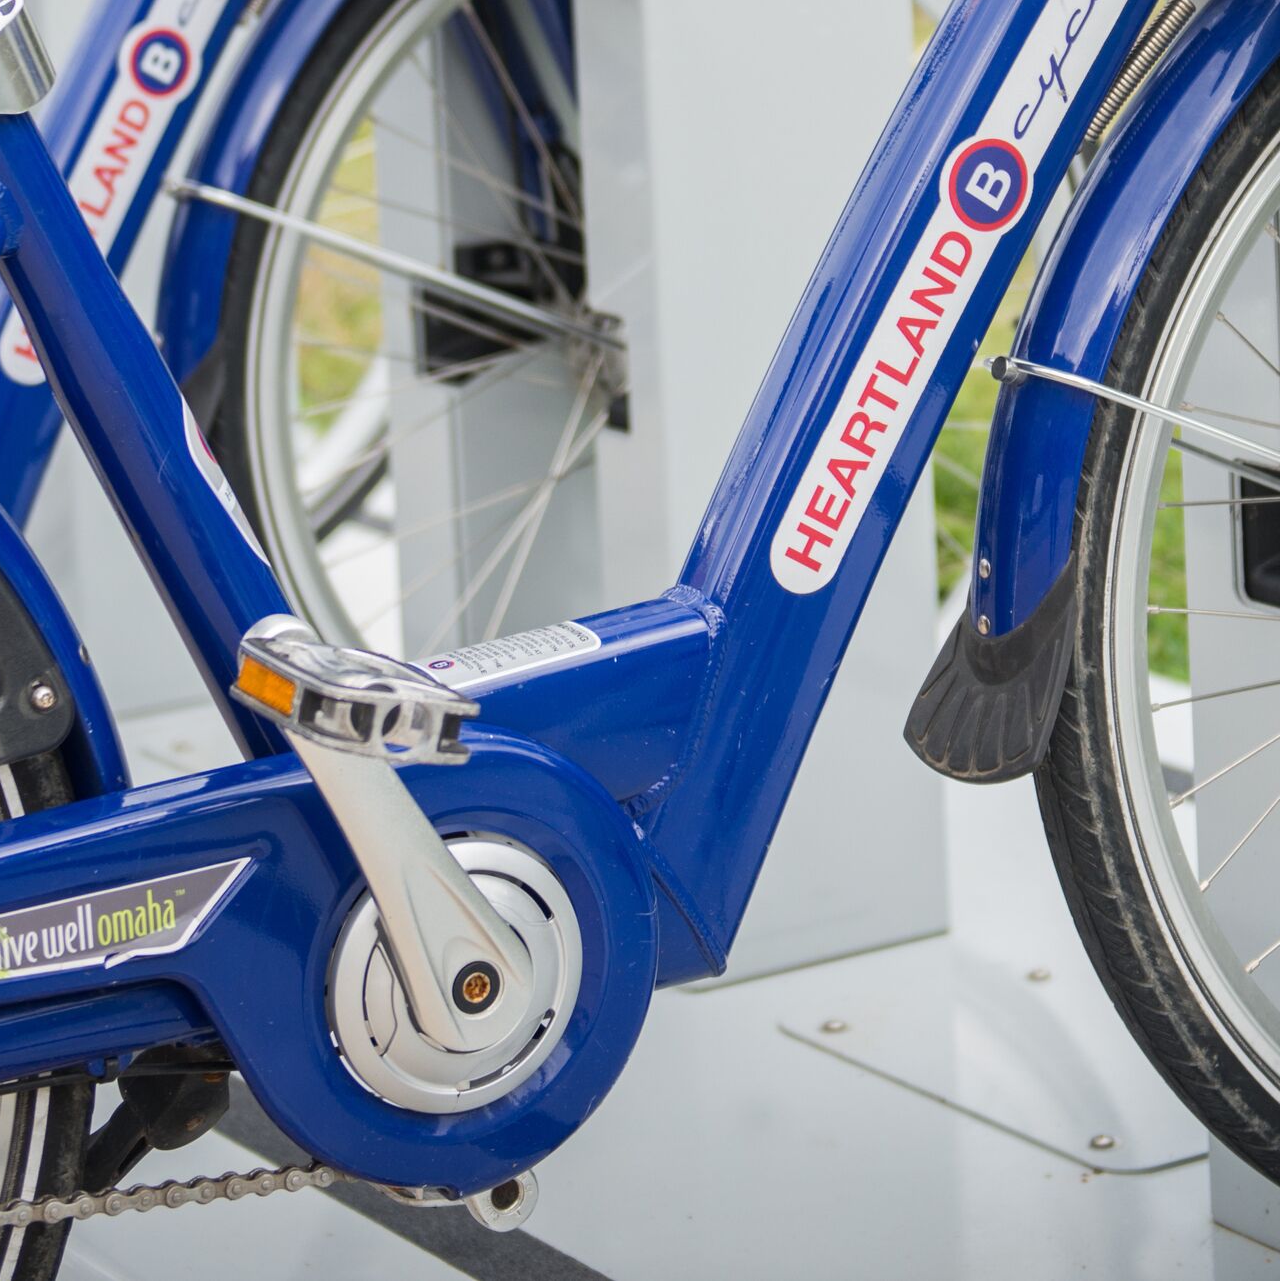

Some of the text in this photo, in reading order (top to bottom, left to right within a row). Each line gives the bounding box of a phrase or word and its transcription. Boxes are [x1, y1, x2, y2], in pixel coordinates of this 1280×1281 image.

[784, 230, 974, 572] HEARTLAND
[41, 903, 94, 960] well
[98, 889, 177, 947] omaha
